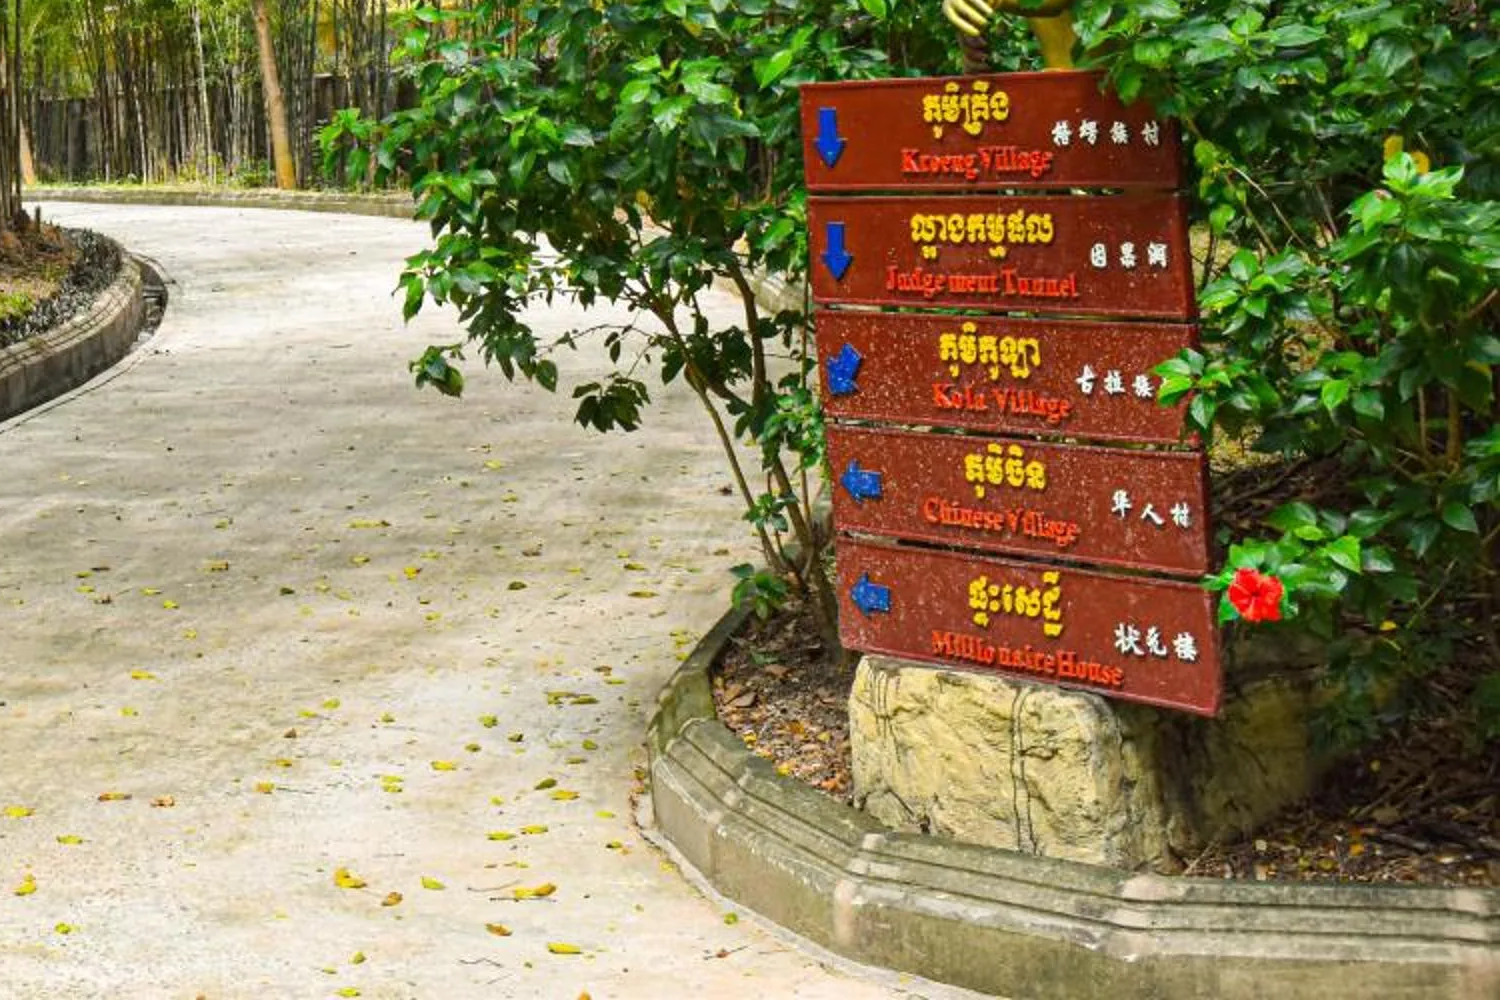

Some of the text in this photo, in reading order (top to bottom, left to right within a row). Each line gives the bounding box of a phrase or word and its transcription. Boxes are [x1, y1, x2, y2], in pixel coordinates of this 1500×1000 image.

[901, 145, 1053, 180] Kroeng Village
[1001, 267, 1080, 298] Tunnel
[991, 386, 1073, 420] Village
[923, 496, 1081, 547] Chinese Village
[1055, 645, 1125, 686] House
